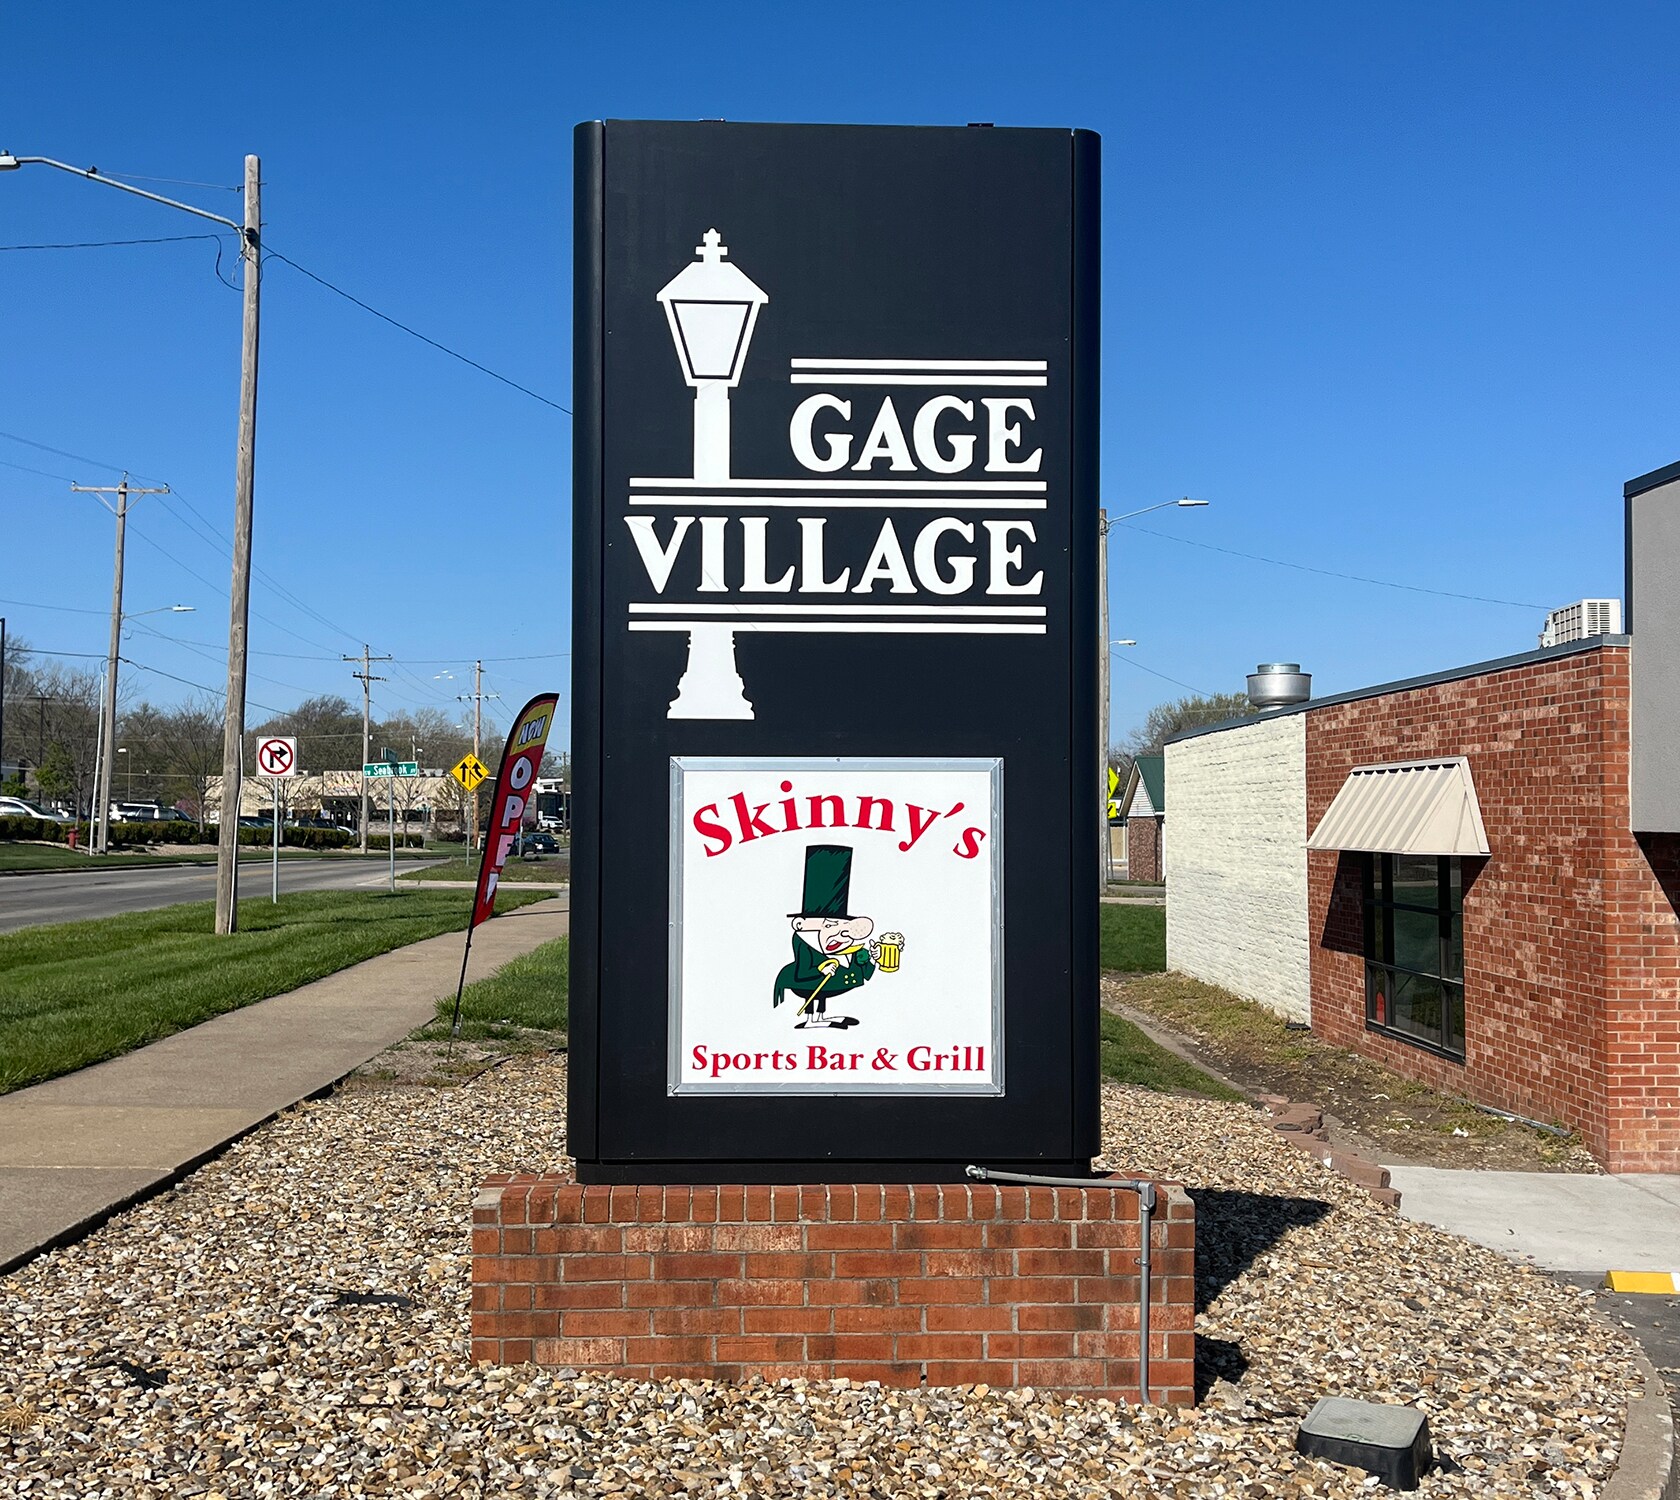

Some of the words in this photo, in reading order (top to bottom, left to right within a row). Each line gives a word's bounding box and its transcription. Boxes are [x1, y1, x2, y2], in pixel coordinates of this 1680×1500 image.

[789, 393, 1044, 474] GAGE
[624, 515, 1044, 595] VILLAGE
[518, 715, 547, 745] NOW
[692, 780, 987, 858] Skinny's
[692, 1045, 798, 1078] Sports
[806, 1045, 865, 1071] Bar
[871, 1048, 898, 1071] &
[906, 1045, 986, 1072] Grill
